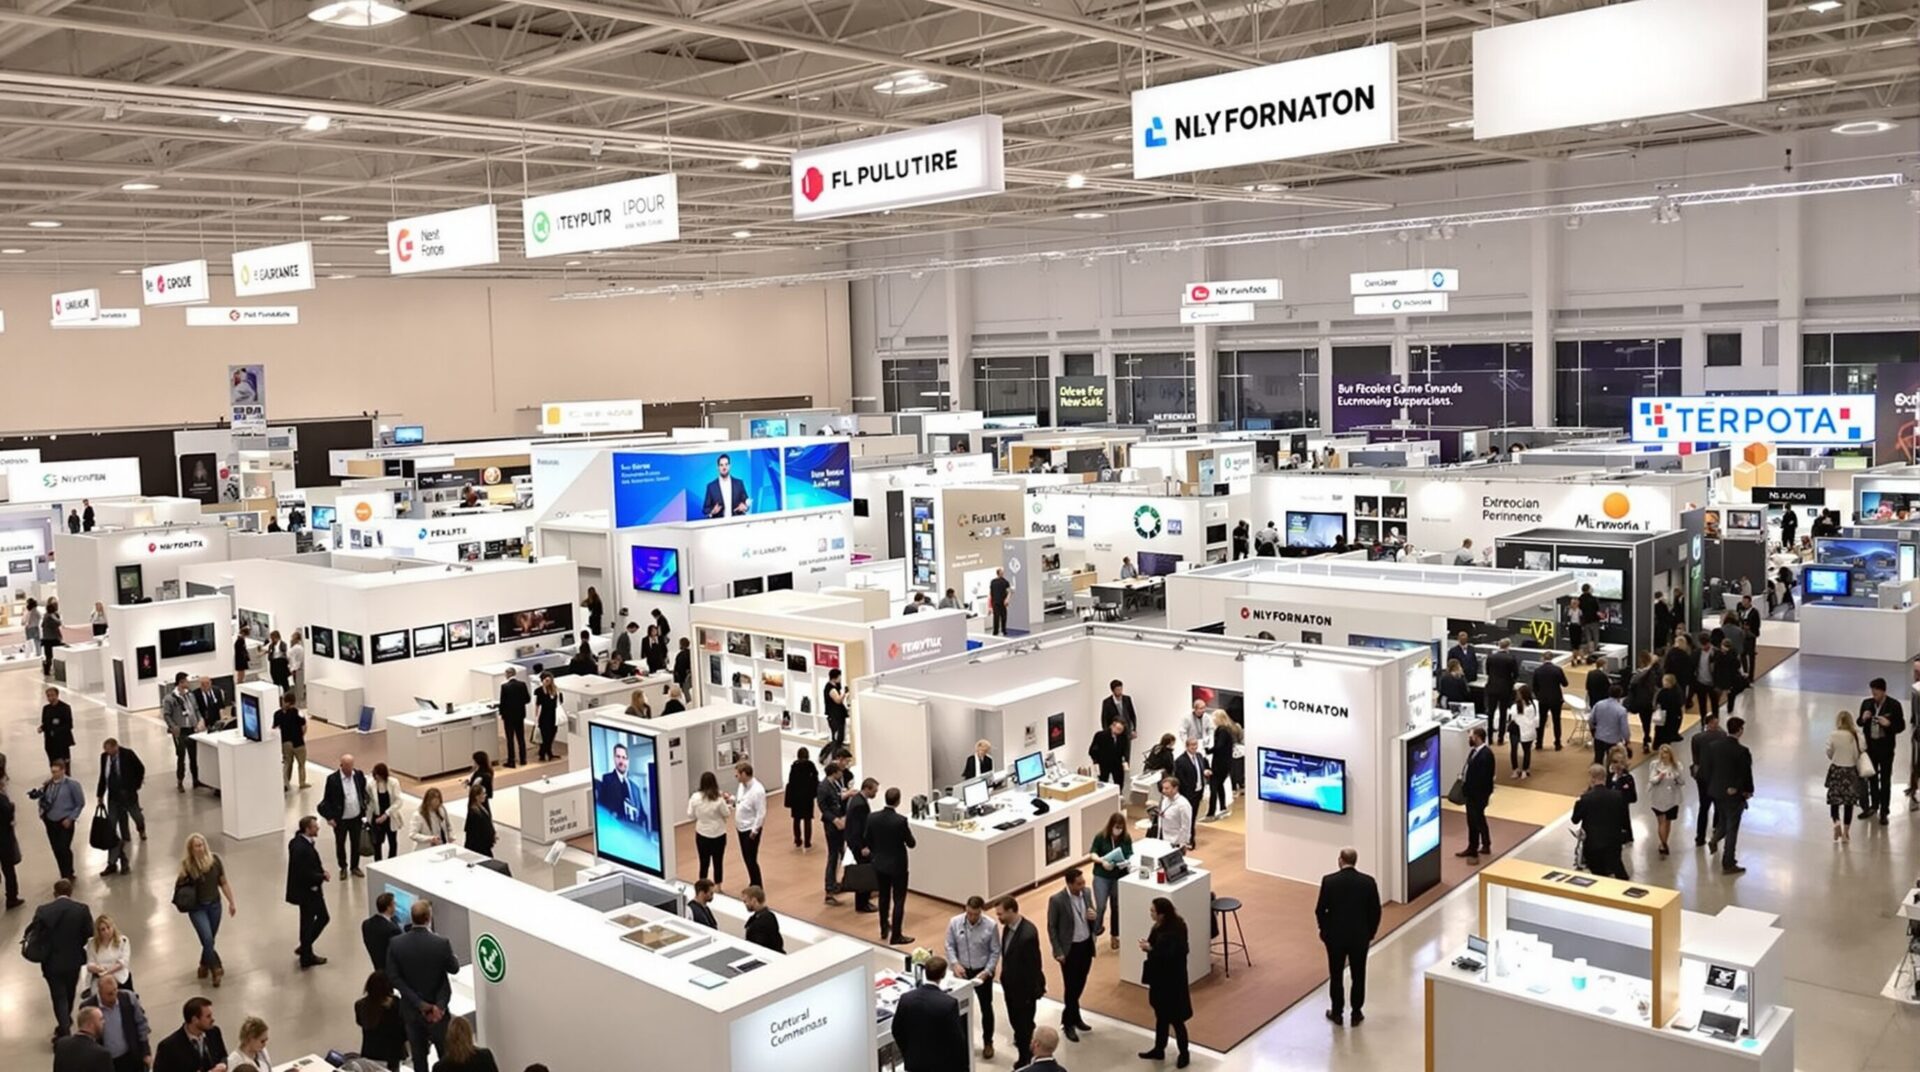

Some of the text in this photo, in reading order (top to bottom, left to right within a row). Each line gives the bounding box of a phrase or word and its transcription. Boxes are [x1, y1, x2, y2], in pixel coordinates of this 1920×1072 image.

[832, 149, 958, 189] FL PULUTIRE
[1676, 407, 1837, 434] TERPOTA
[1282, 699, 1348, 718] TORNATON
